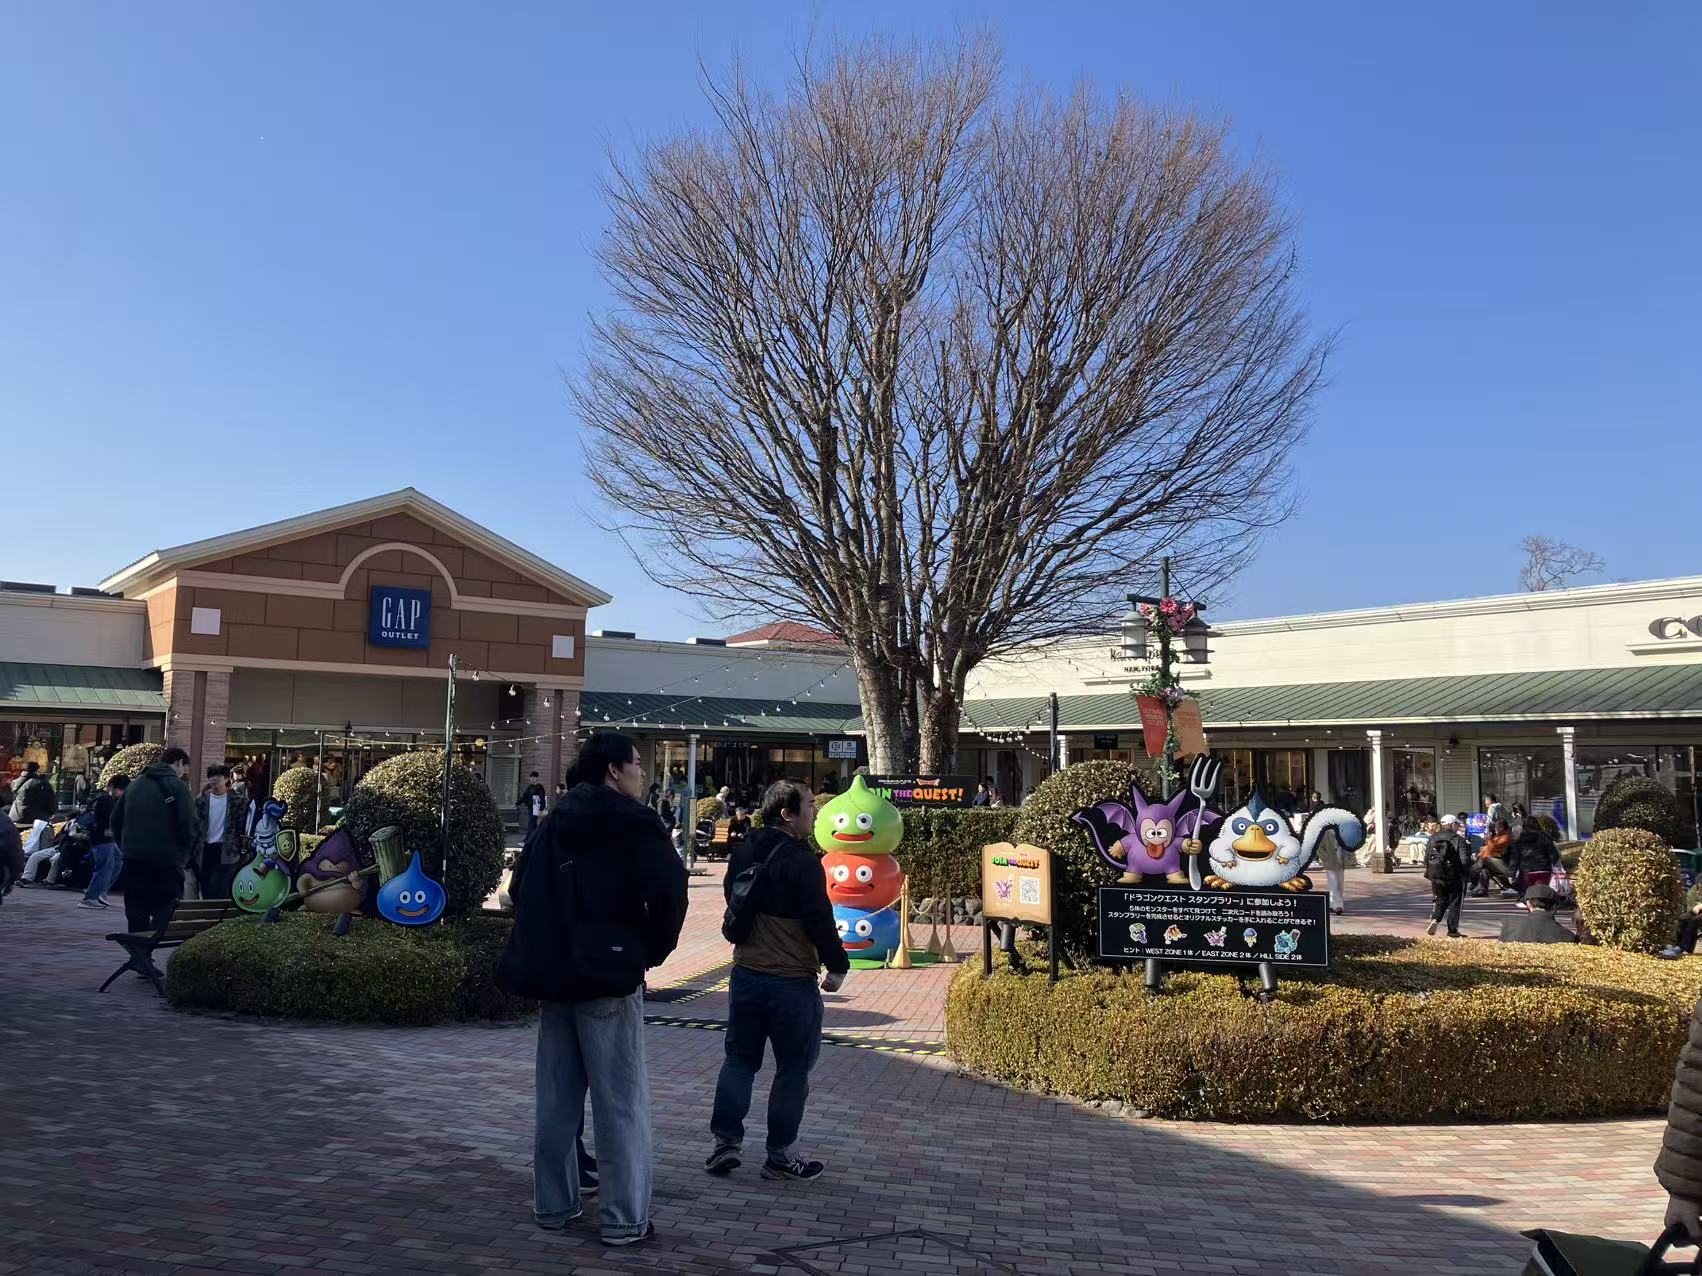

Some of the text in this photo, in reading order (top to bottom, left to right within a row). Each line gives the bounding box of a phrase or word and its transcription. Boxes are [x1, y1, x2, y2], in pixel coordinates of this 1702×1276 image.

[382, 597, 420, 630] GAP
[381, 631, 419, 639] OUTLET
[893, 789, 912, 798] THE
[912, 788, 964, 802] QUEST!
[1124, 893, 1186, 903] 「ドラゴンクエスト
[1164, 948, 1182, 956] ZONE
